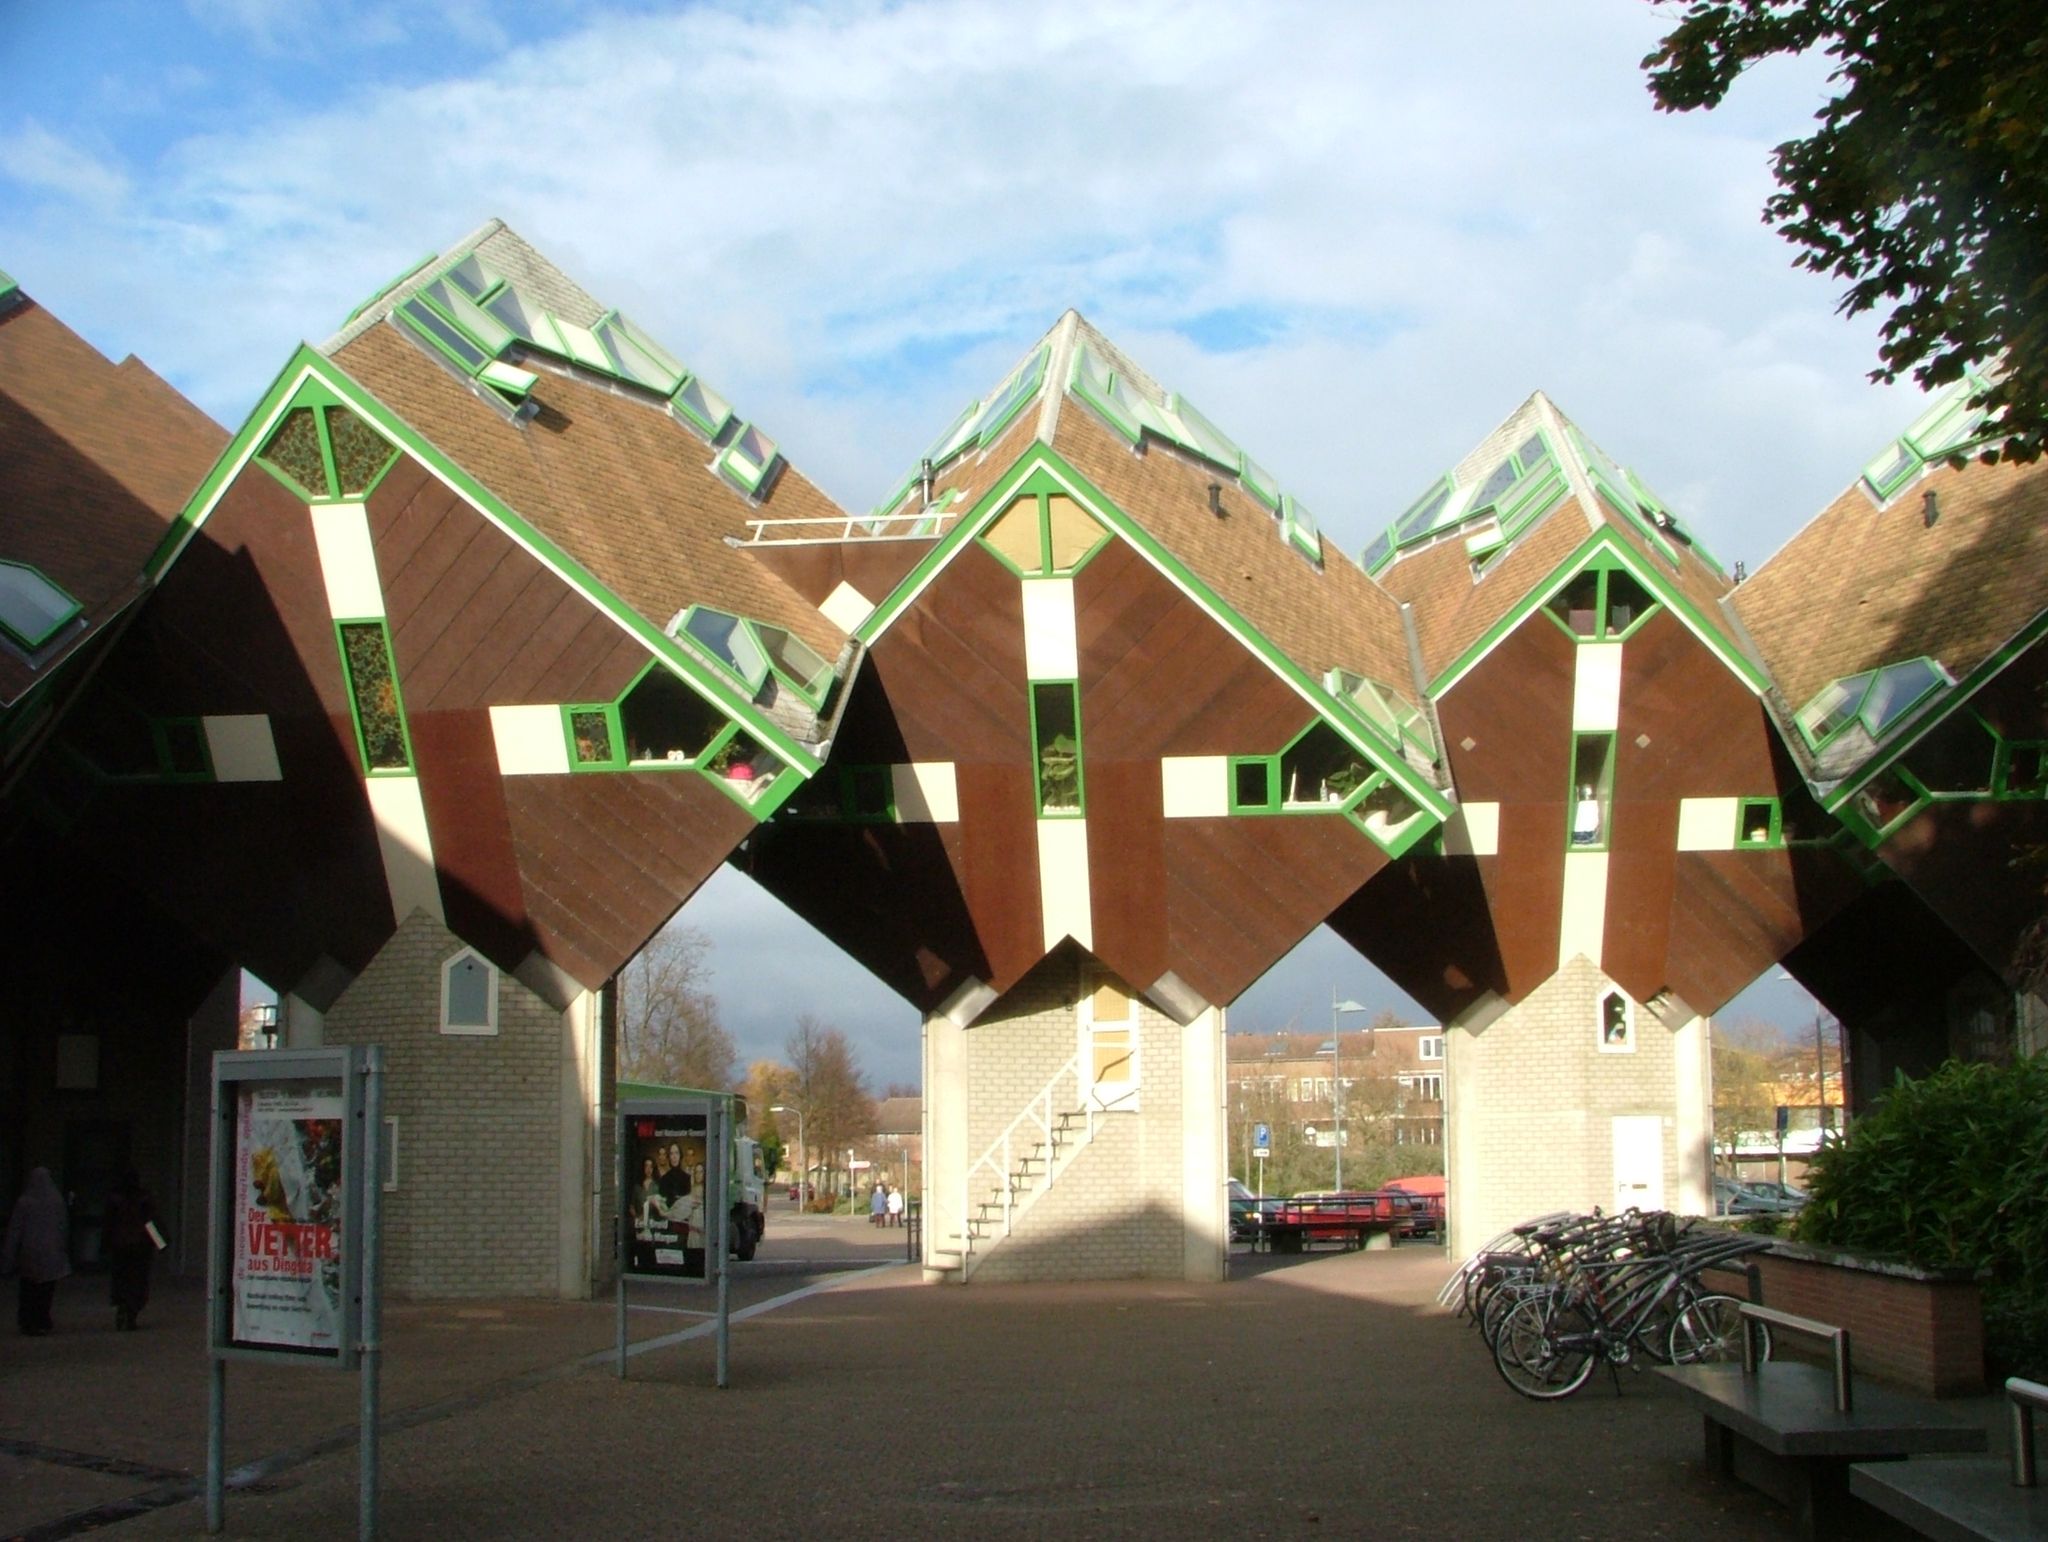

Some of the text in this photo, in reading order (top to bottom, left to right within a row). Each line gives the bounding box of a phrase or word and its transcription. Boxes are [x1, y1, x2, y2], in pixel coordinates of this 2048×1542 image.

[249, 1207, 266, 1222] Der
[249, 1223, 332, 1259] VETTER
[248, 1259, 268, 1272] aus
